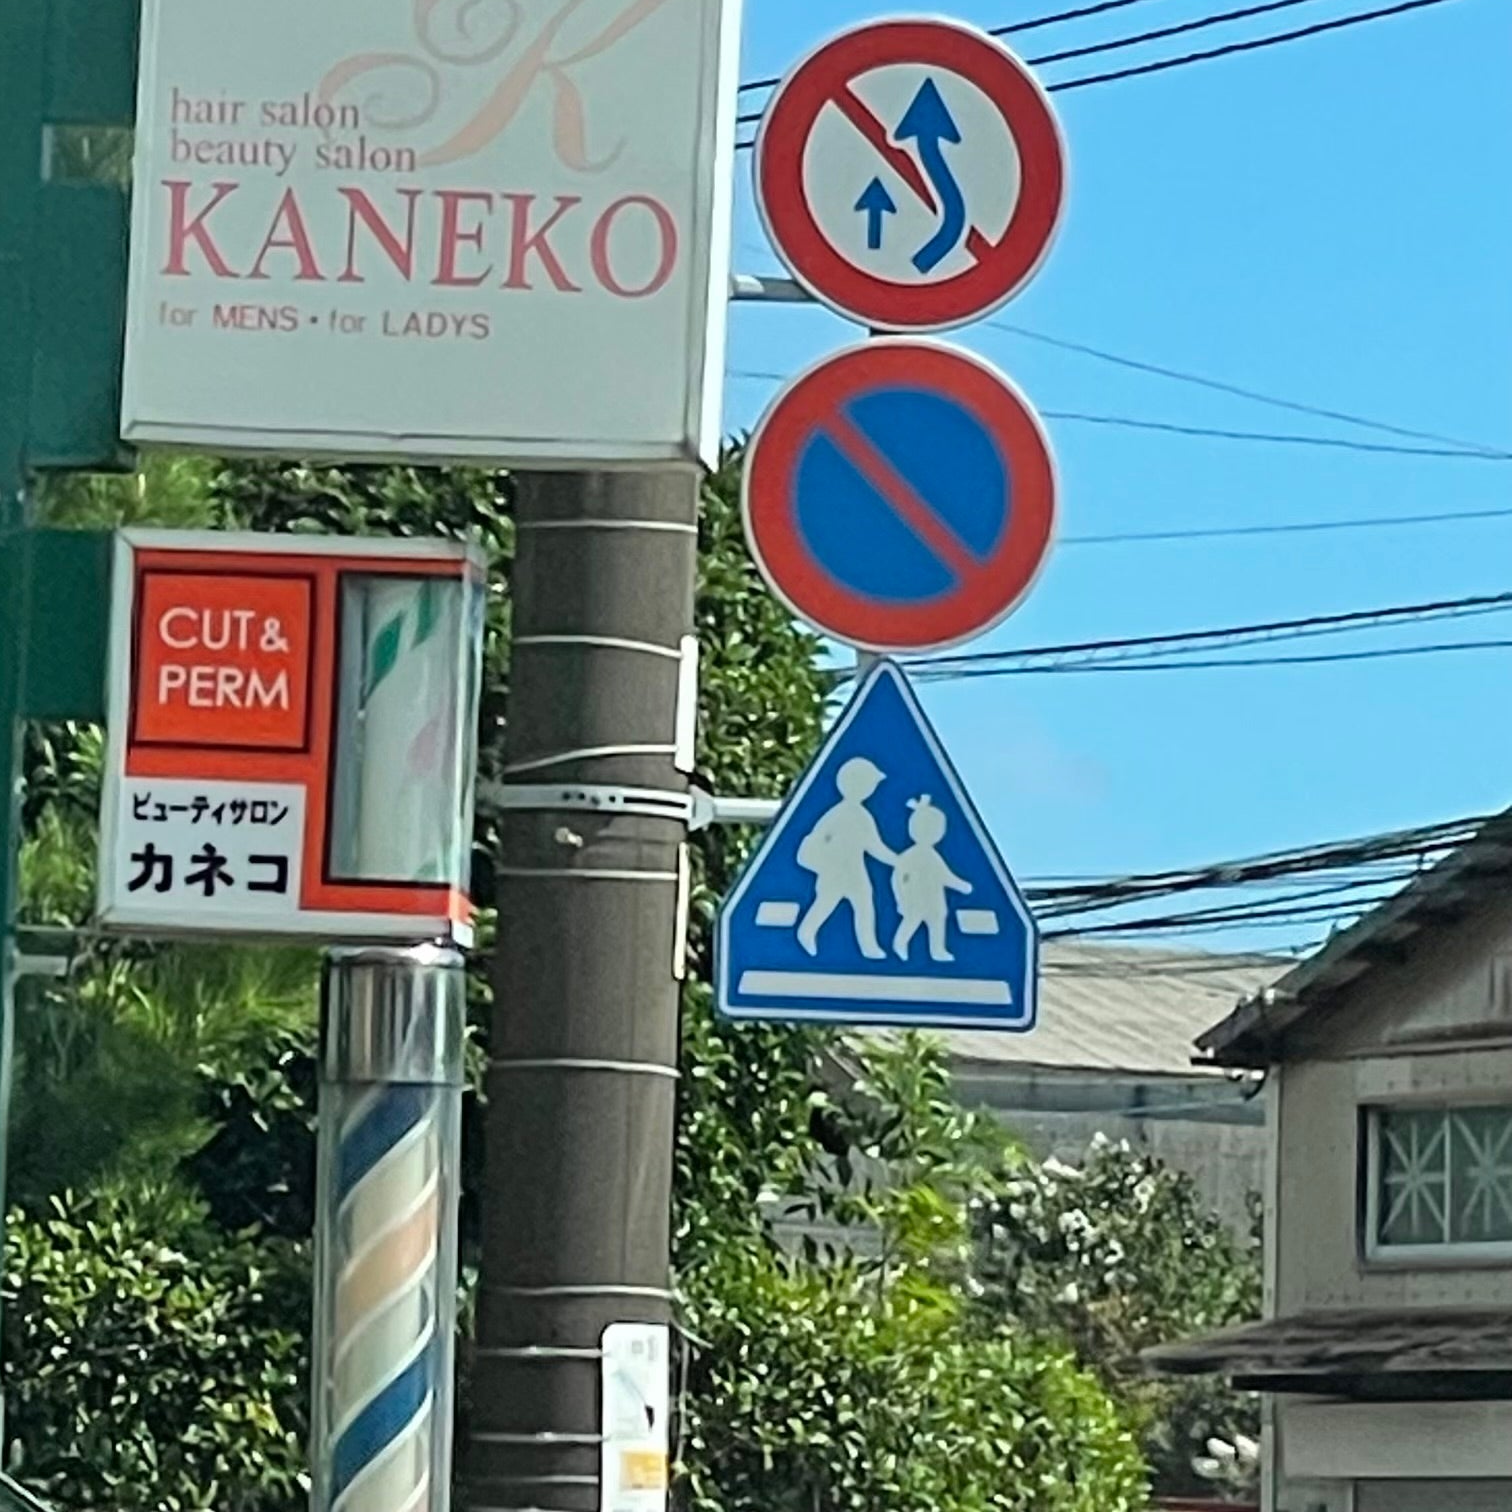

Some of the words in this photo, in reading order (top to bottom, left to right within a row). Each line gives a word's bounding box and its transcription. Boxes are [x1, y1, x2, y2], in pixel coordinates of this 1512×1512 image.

[170, 86, 246, 126] hair
[261, 92, 360, 130] salon
[170, 130, 296, 177] beauty
[315, 134, 417, 173] salon
[160, 178, 679, 299] KANEKO
[158, 301, 198, 327] for
[213, 304, 299, 332] MENS
[328, 305, 366, 334] for
[382, 310, 491, 339] LADYS
[157, 664, 289, 710] PERM
[132, 792, 289, 826] ビューティサロン
[127, 842, 289, 897] カネコ
